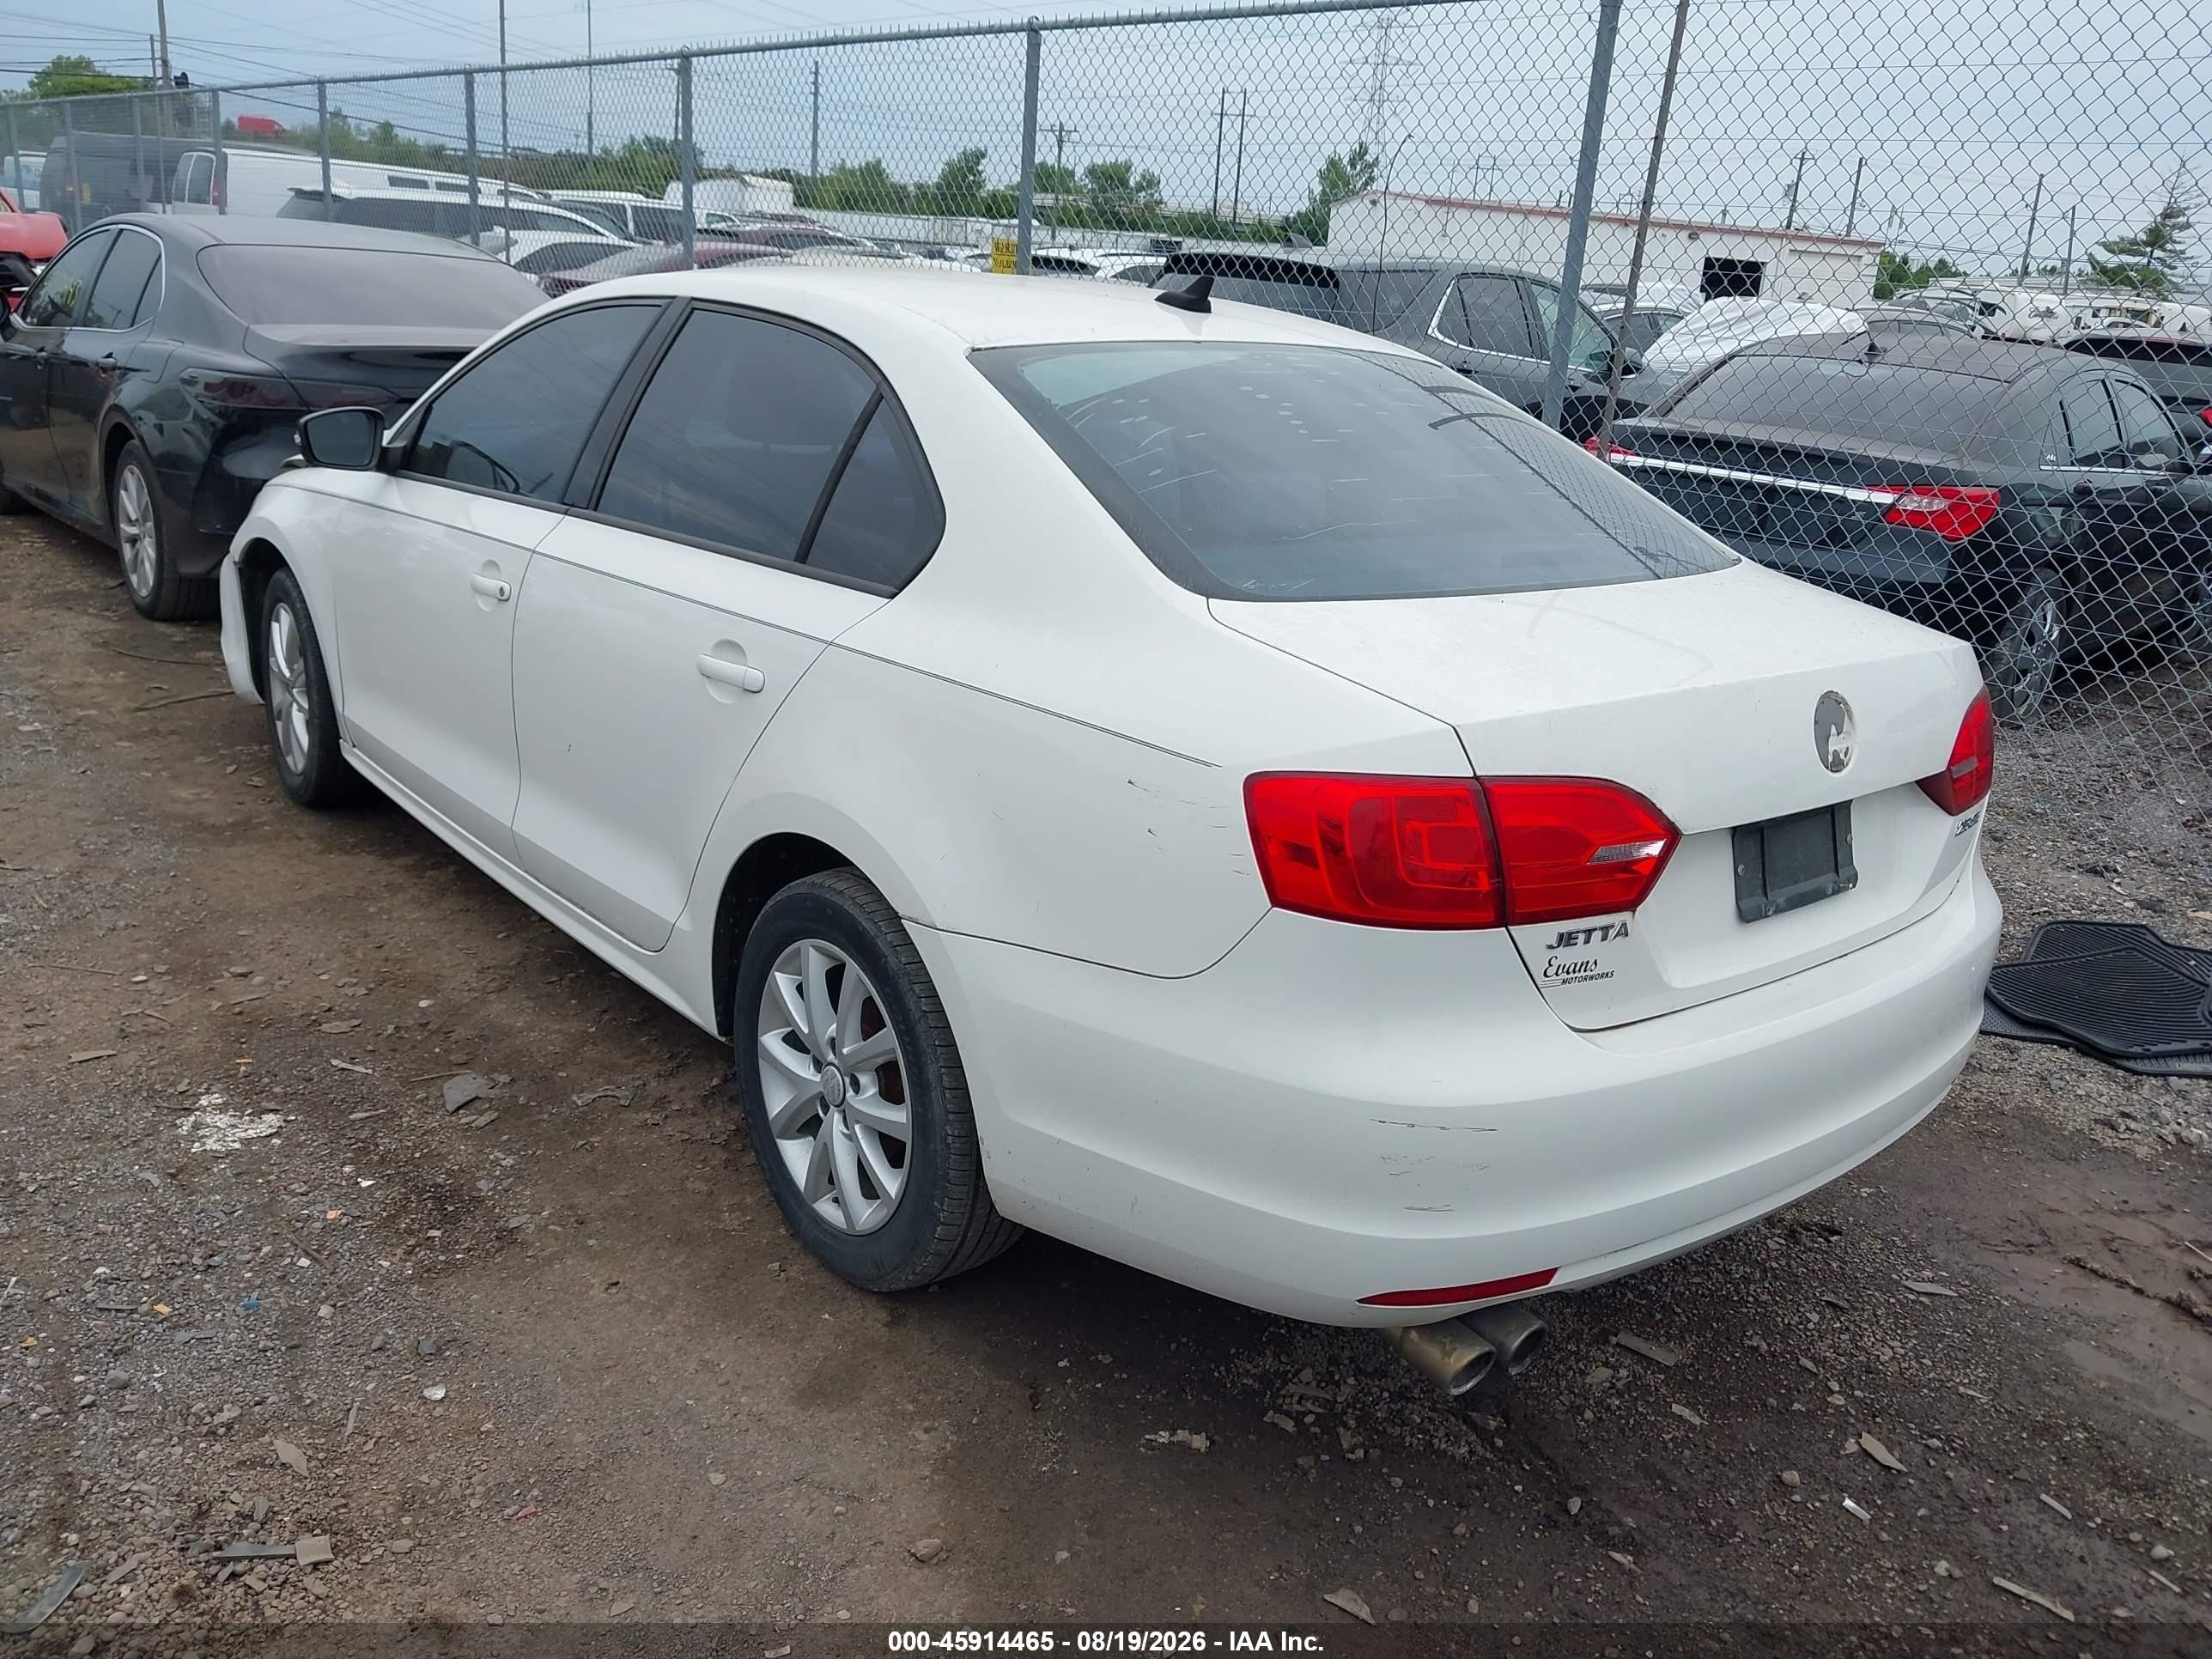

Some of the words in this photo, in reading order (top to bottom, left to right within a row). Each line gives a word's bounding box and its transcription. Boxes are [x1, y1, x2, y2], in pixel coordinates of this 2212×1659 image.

[1545, 919, 1629, 950] JETTA
[1542, 955, 1598, 978] Evans
[1560, 969, 1615, 986] MOTORWORKS
